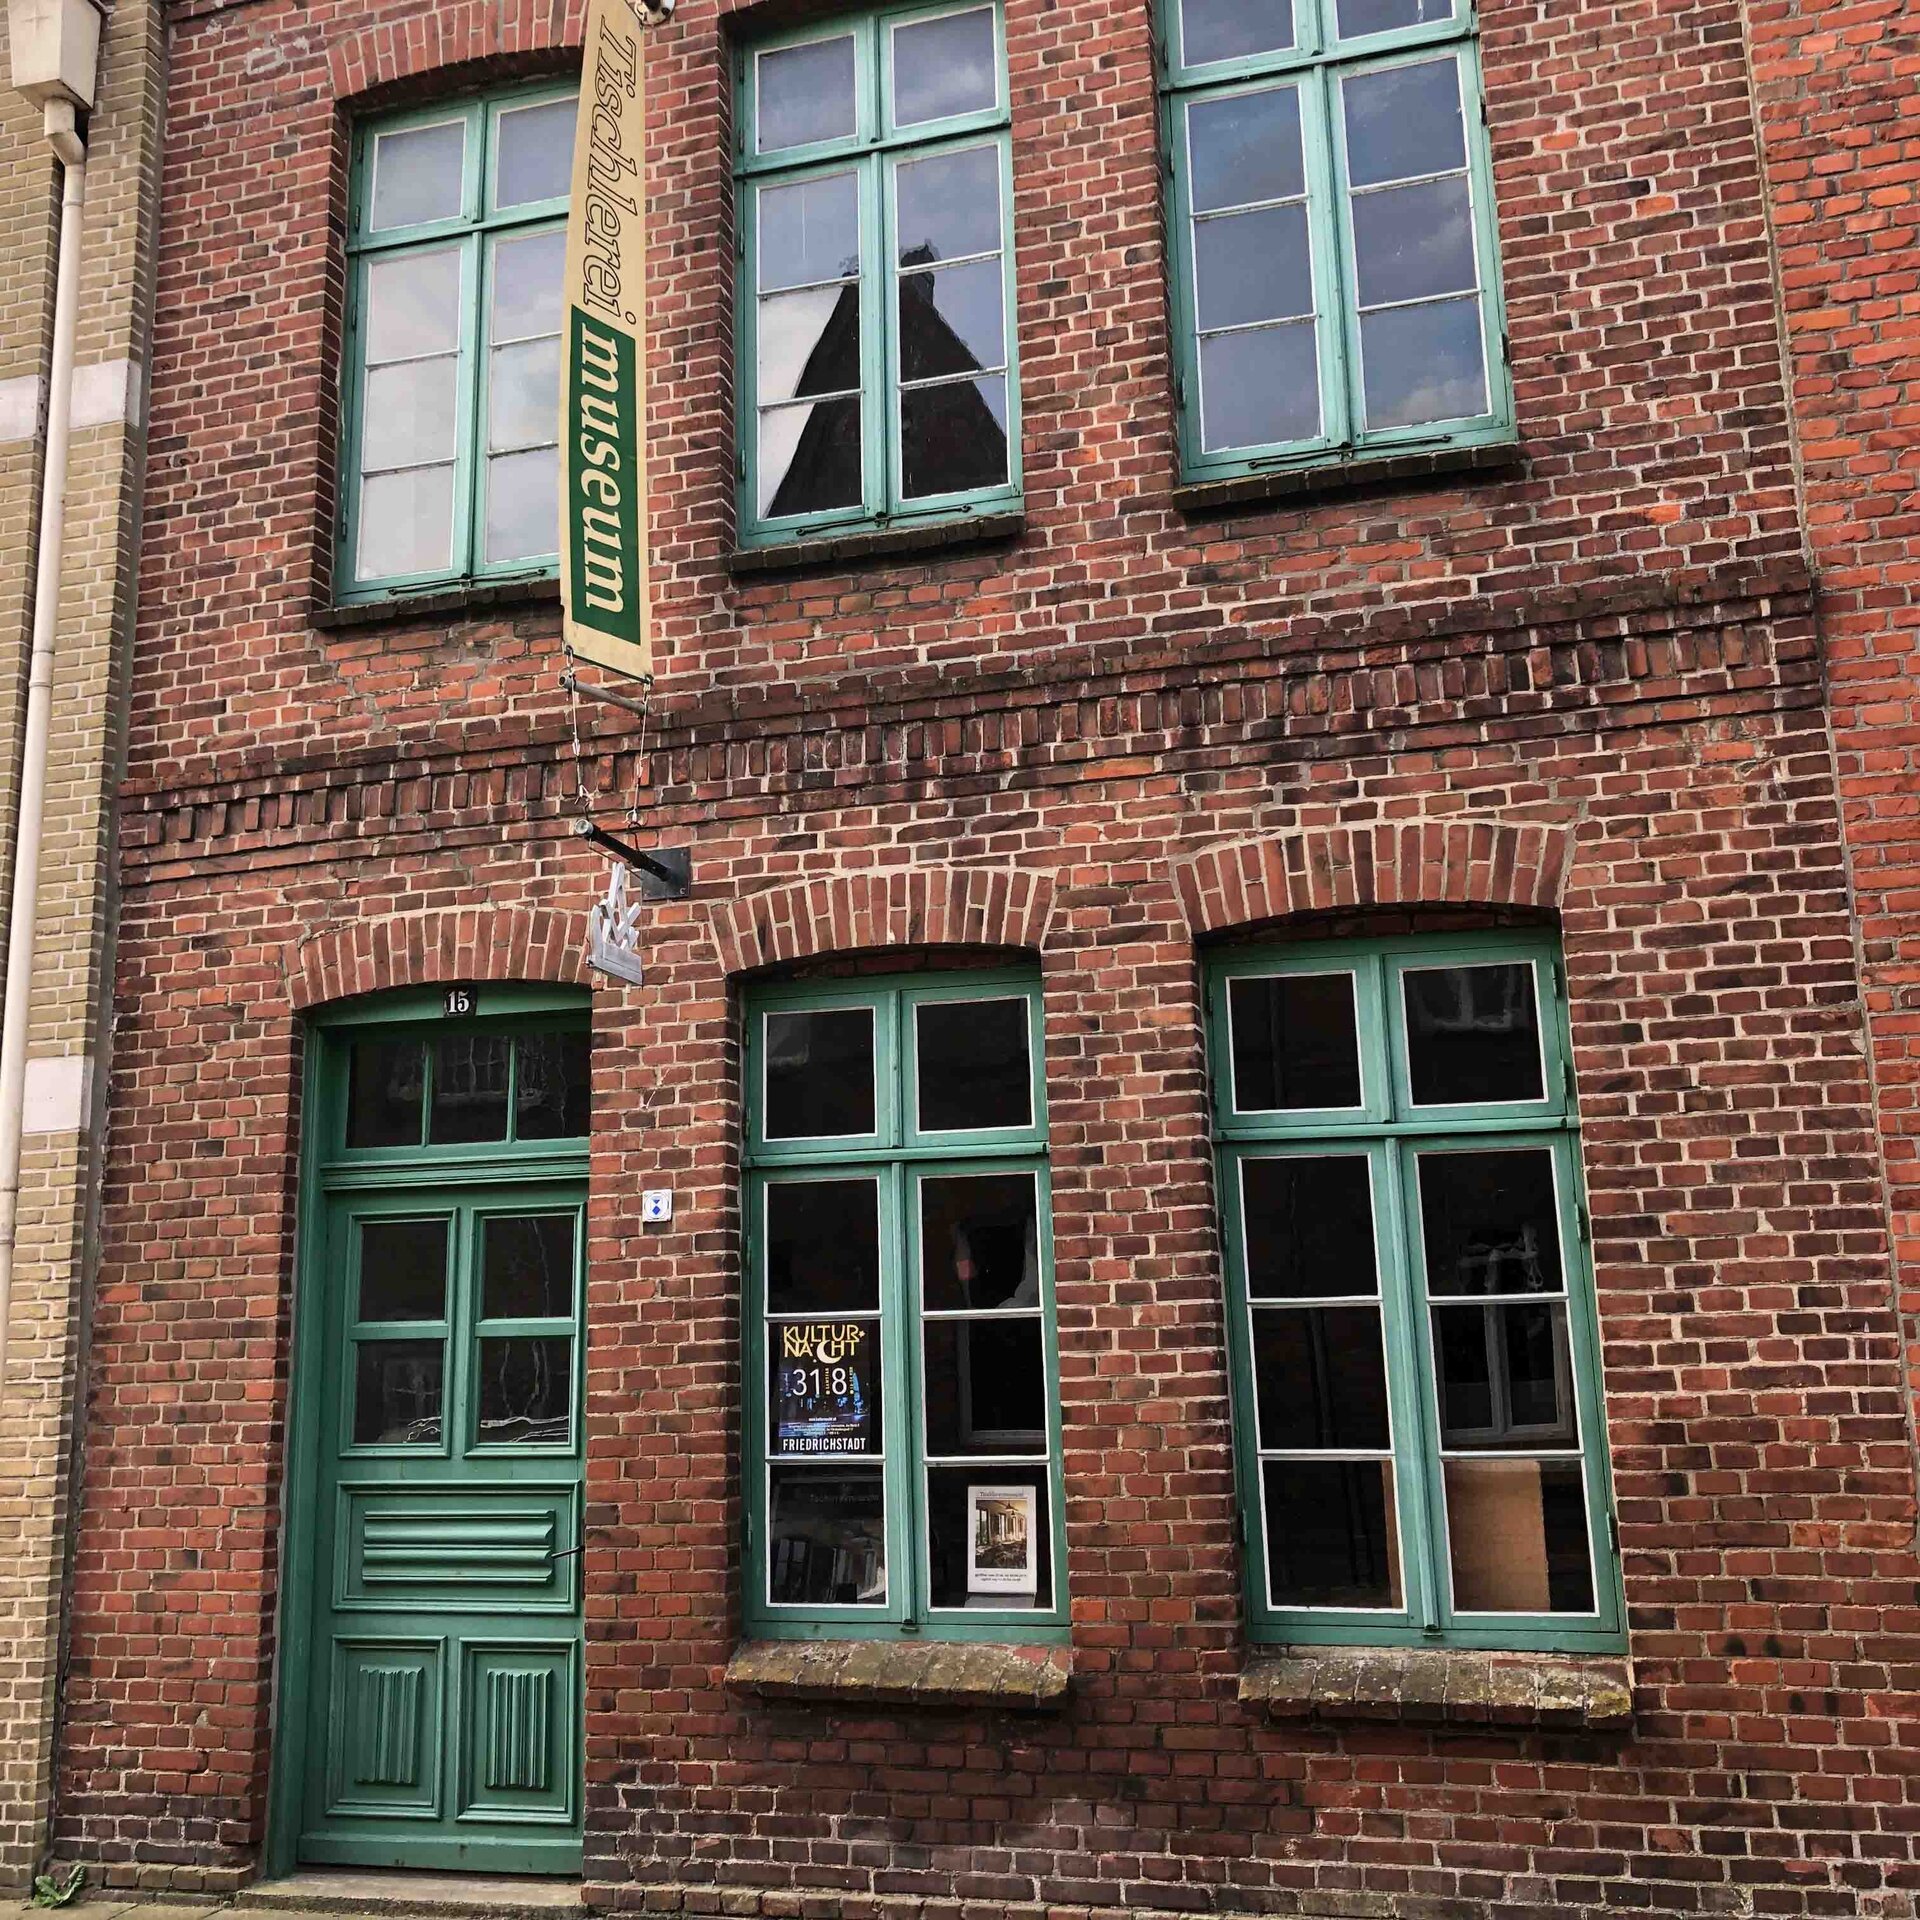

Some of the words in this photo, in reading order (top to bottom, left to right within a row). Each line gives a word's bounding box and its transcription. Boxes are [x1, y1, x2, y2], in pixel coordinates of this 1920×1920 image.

[583, 15, 638, 325] Tischlerei
[580, 321, 624, 614] museum
[448, 990, 470, 1013] 15
[783, 1324, 860, 1343] KULTUR
[792, 1368, 820, 1397] 31
[831, 1367, 848, 1395] 8
[783, 1437, 866, 1451] FRIEDRICHSTADT
